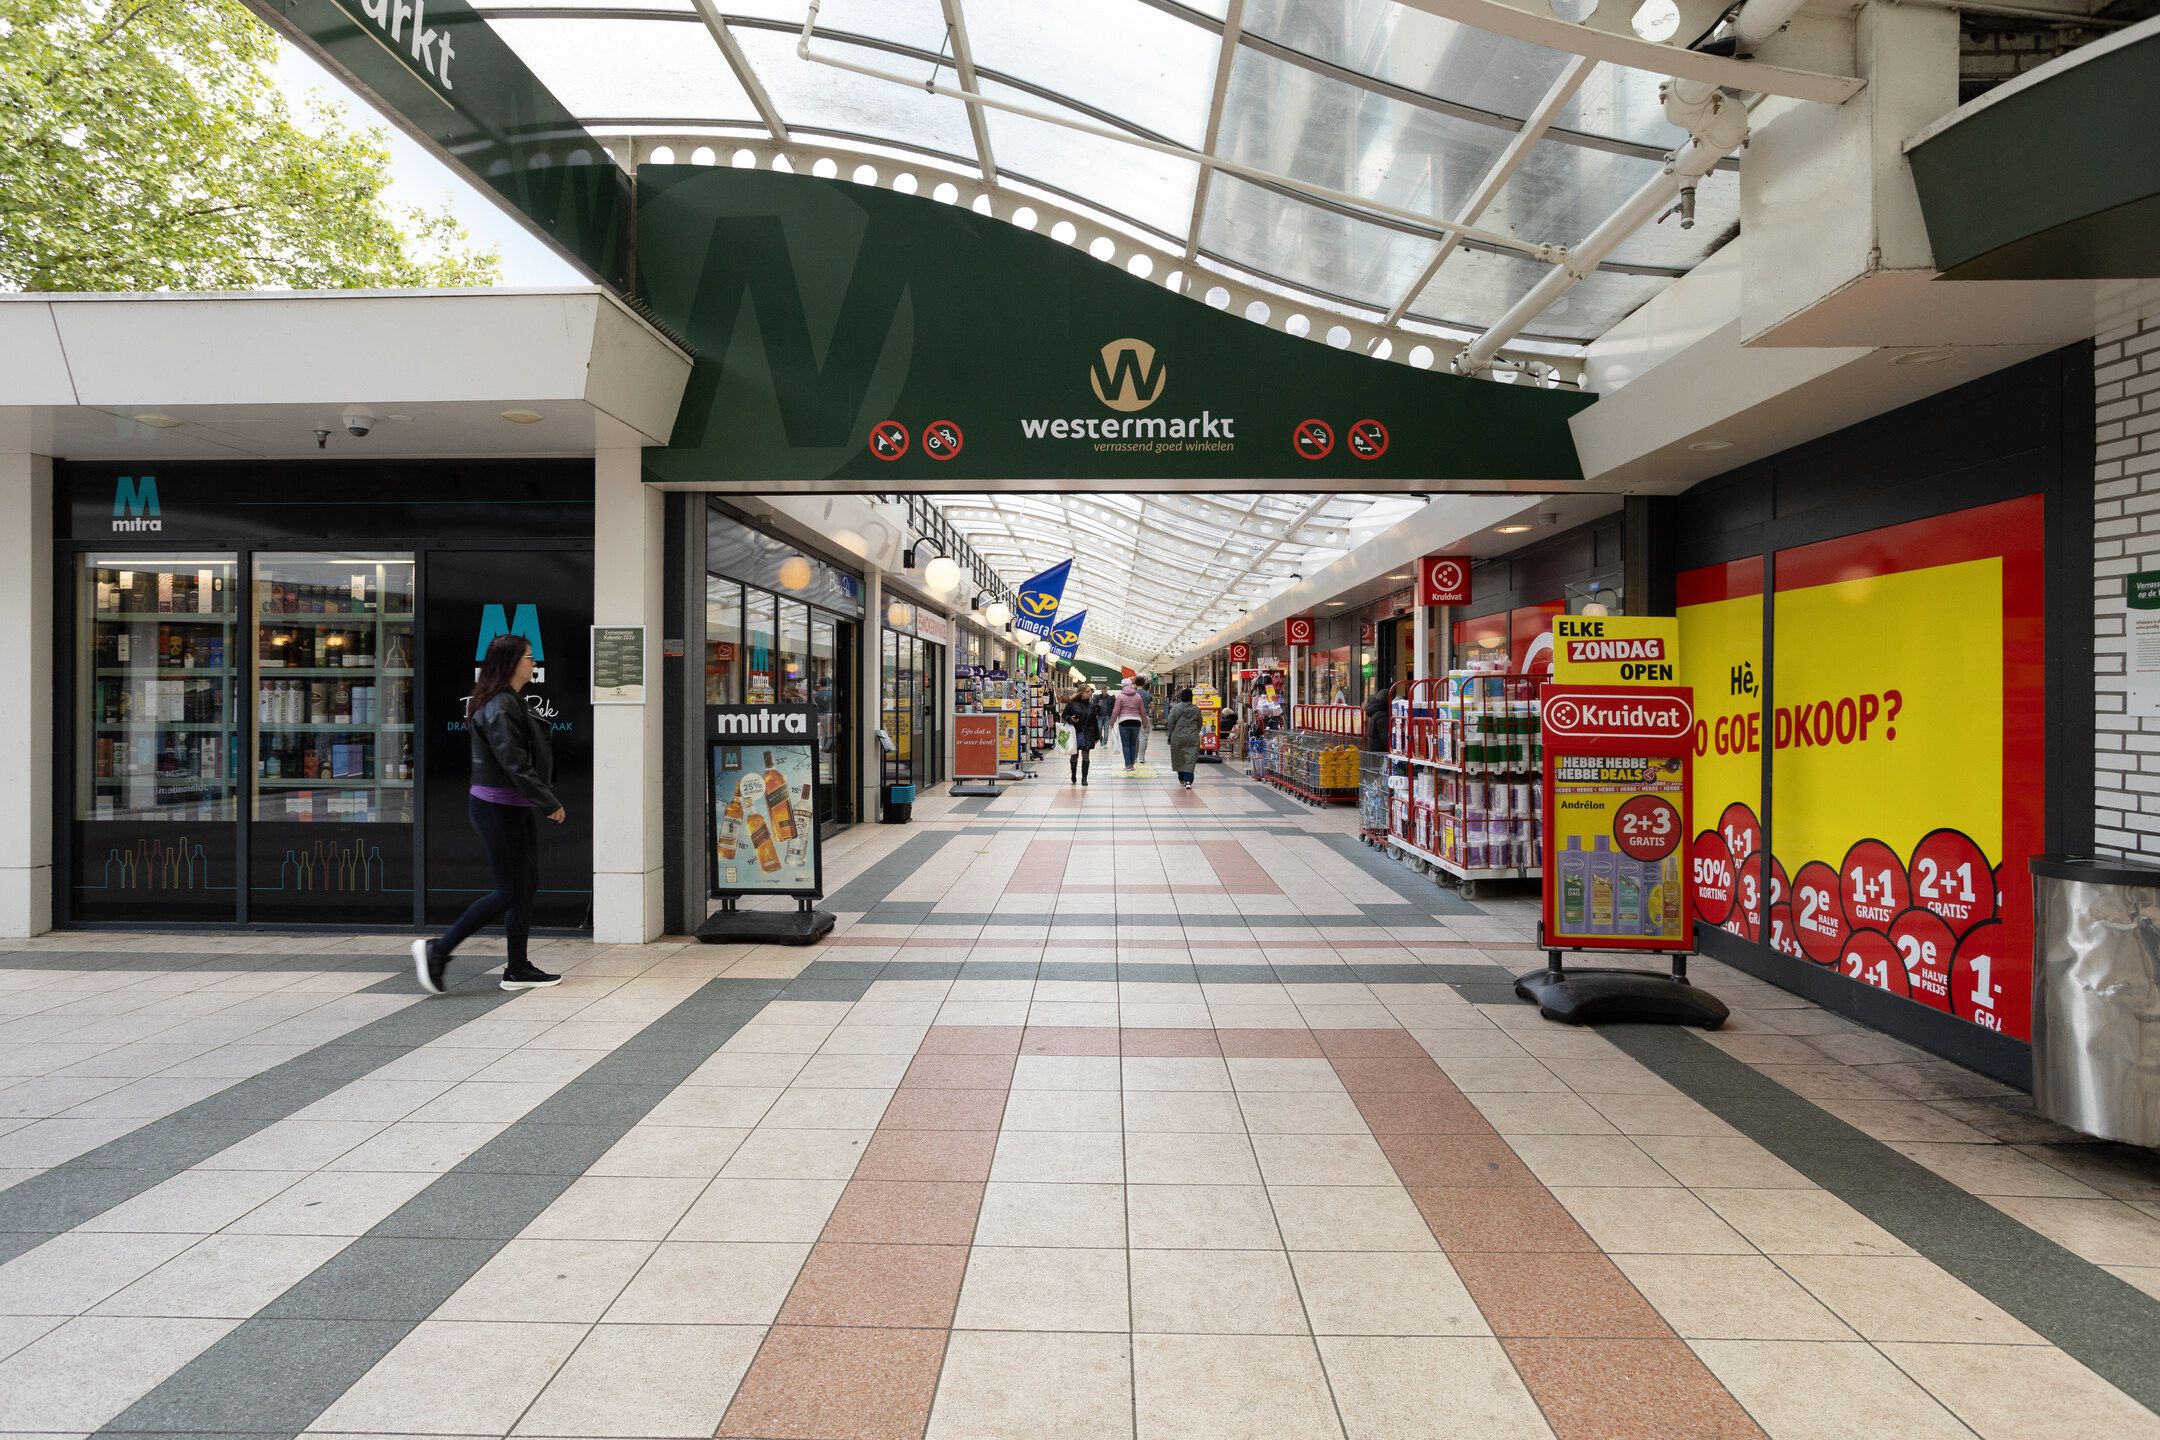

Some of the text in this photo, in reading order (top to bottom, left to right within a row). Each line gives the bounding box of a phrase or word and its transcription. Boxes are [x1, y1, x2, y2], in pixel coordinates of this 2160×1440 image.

[354, 0, 456, 90] arkt
[1020, 411, 1235, 439] westermarkt
[1093, 441, 1234, 454] verrassend goed winkelen
[113, 476, 161, 516] M
[112, 517, 162, 531] mitra
[1432, 593, 1463, 601] Kruidvat
[1016, 613, 1050, 637] rimera
[1558, 621, 1605, 637] ELKE
[1050, 643, 1073, 659] rimera
[1572, 639, 1660, 660] ZONDAG
[1620, 663, 1673, 681] OPEN
[1731, 660, 1760, 698] Hè,
[718, 708, 807, 734] mitra
[1582, 704, 1680, 728] Kruidvat
[961, 728, 973, 737] Fijn
[974, 727, 985, 735] dat
[1203, 736, 1216, 744] 1+1
[1694, 719, 1708, 757] O
[979, 738, 996, 746] bent!
[1563, 756, 1647, 769] HEBBE HEBBE
[1557, 768, 1643, 781] HEBBE DEALS
[742, 782, 763, 792] 25%
[1561, 800, 1605, 810] Andrélon
[1622, 807, 1672, 834] 2+3
[1629, 836, 1665, 846] GRATIS
[1724, 825, 1752, 858] 1+1
[1693, 857, 1731, 887] 50%
[1917, 857, 1976, 903] 2+1
[1699, 886, 1727, 902] KORTING
[1850, 866, 1896, 907] 1+1
[1799, 885, 1830, 931] 2e
[1818, 913, 1839, 927] HALVE
[1897, 934, 1937, 988] 2e
[1846, 952, 1892, 992] 2+1
[1922, 968, 1948, 984] HALVE
